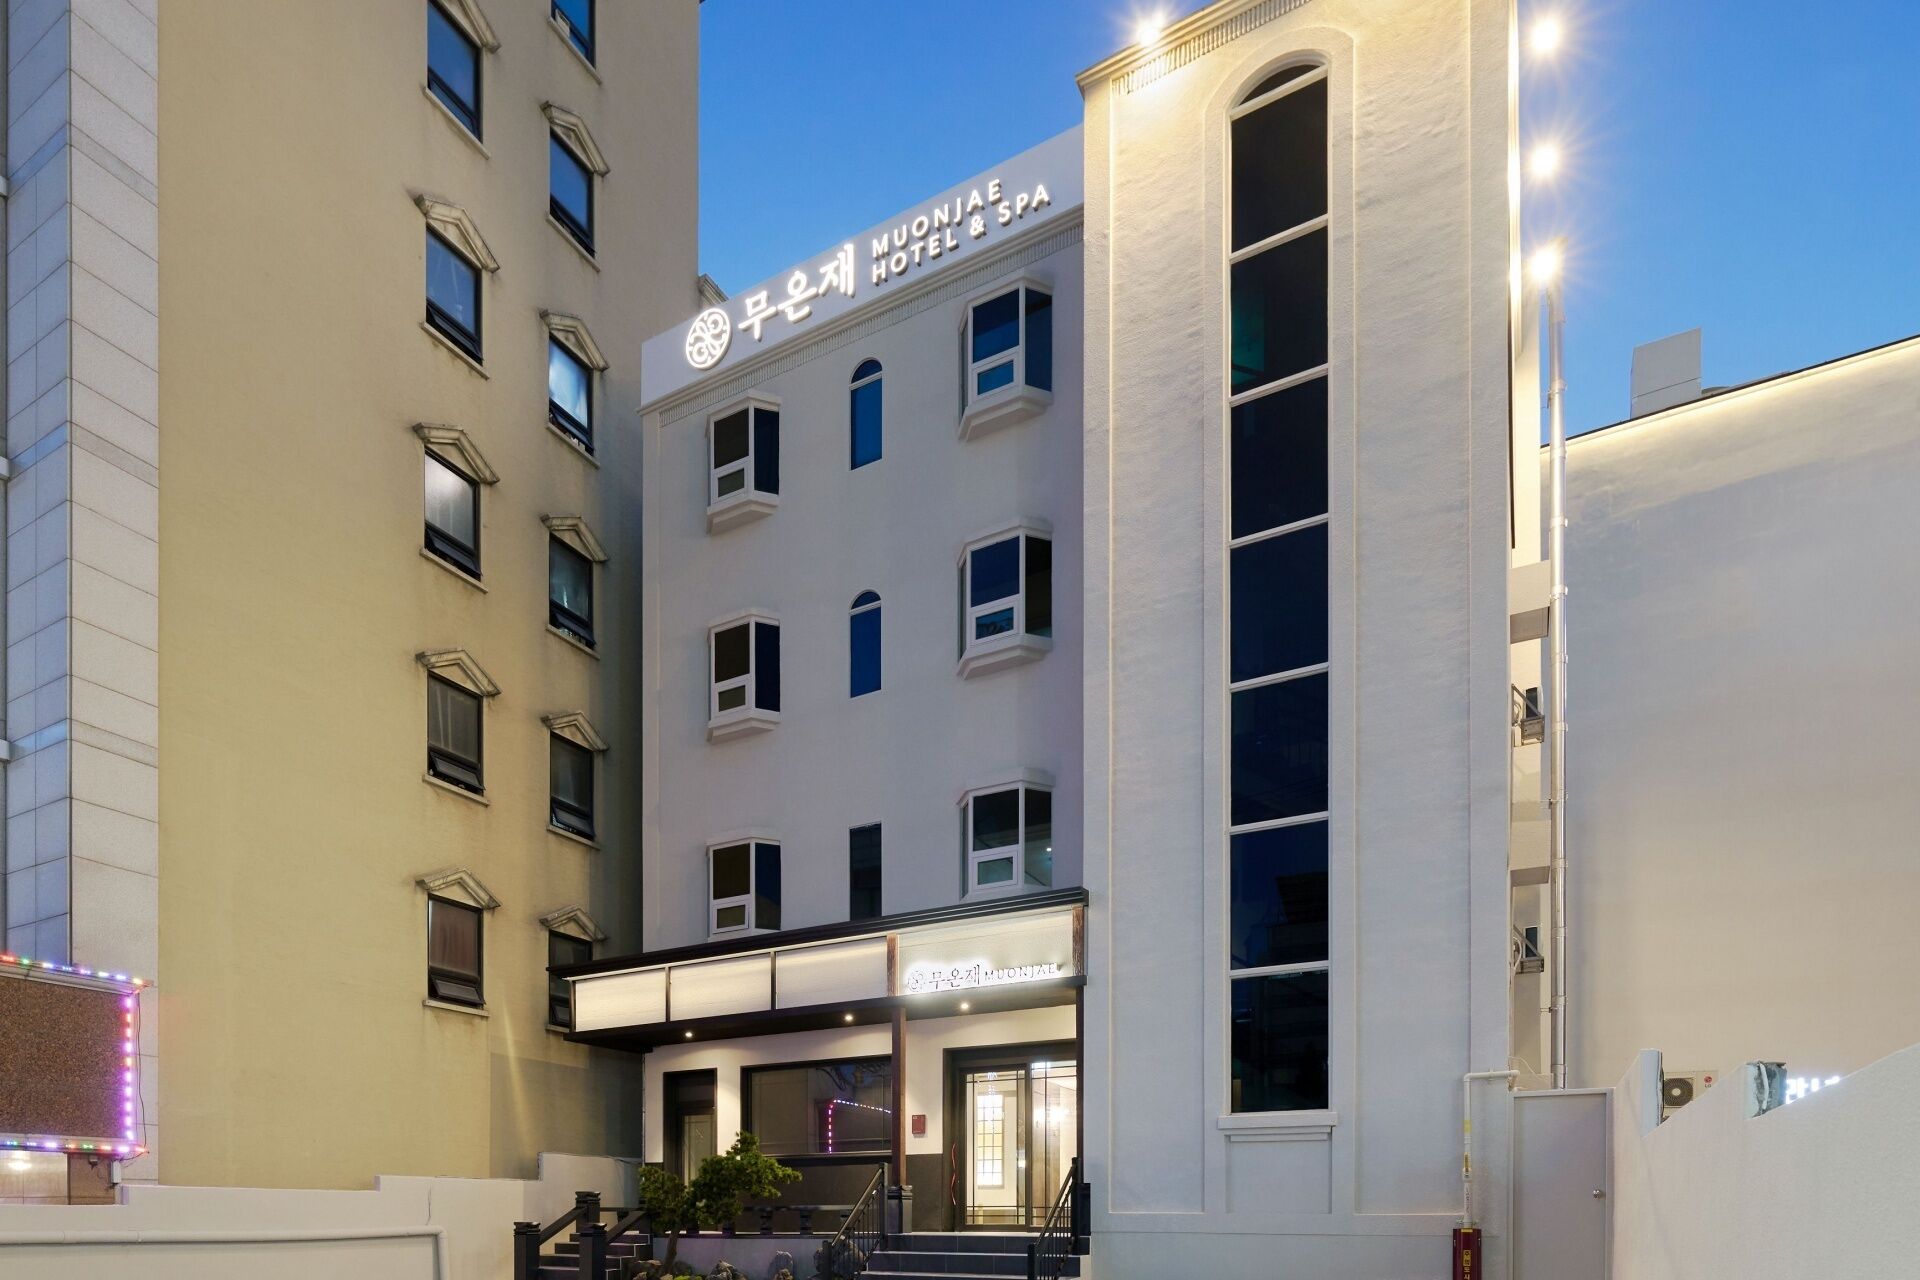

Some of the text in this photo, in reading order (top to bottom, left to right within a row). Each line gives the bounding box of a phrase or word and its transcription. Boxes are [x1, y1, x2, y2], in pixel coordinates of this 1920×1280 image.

[872, 178, 1001, 260] MUONJAE
[872, 184, 1050, 286] HOTEL & SPA
[738, 244, 857, 341] 무은재
[928, 962, 1056, 990] 무은재 MUONJAE
